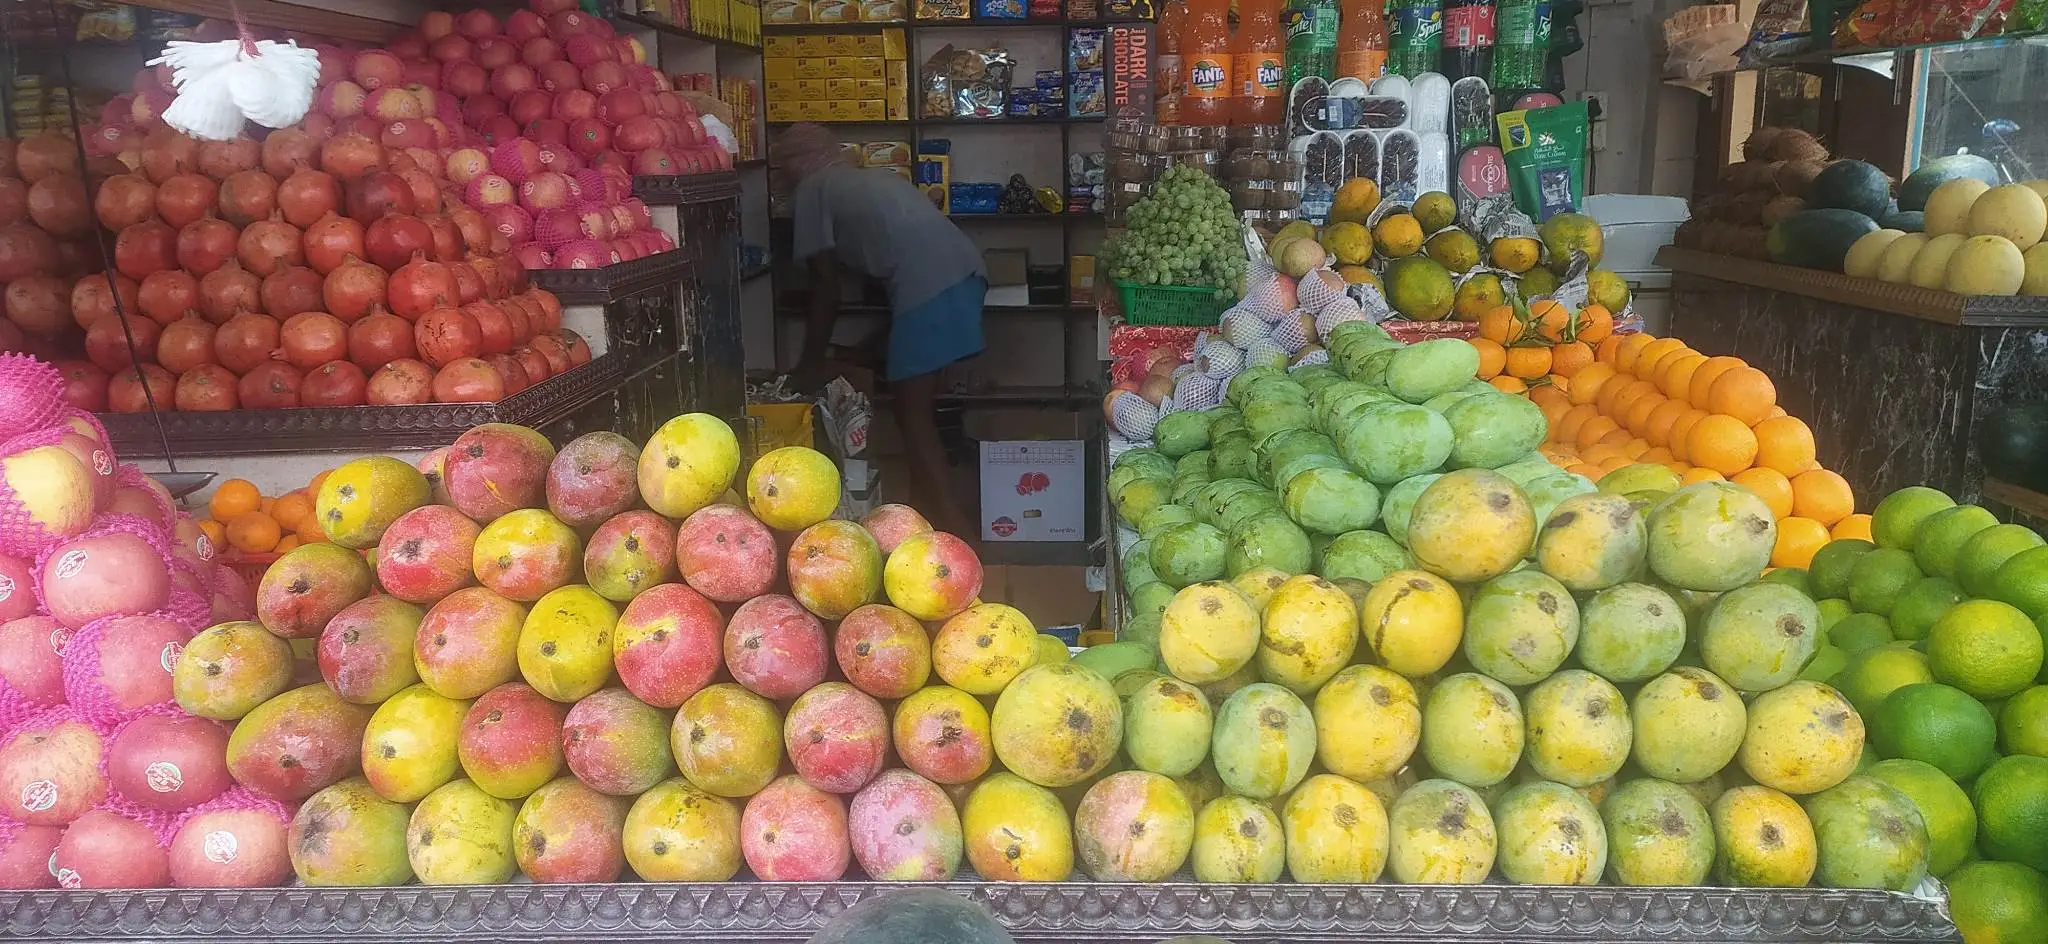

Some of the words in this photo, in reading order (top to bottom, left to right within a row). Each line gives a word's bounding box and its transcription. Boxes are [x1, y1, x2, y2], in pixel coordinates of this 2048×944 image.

[1114, 28, 1128, 105] CHOCOLATE
[1130, 36, 1147, 80] DARK
[1192, 66, 1225, 83] FANTA
